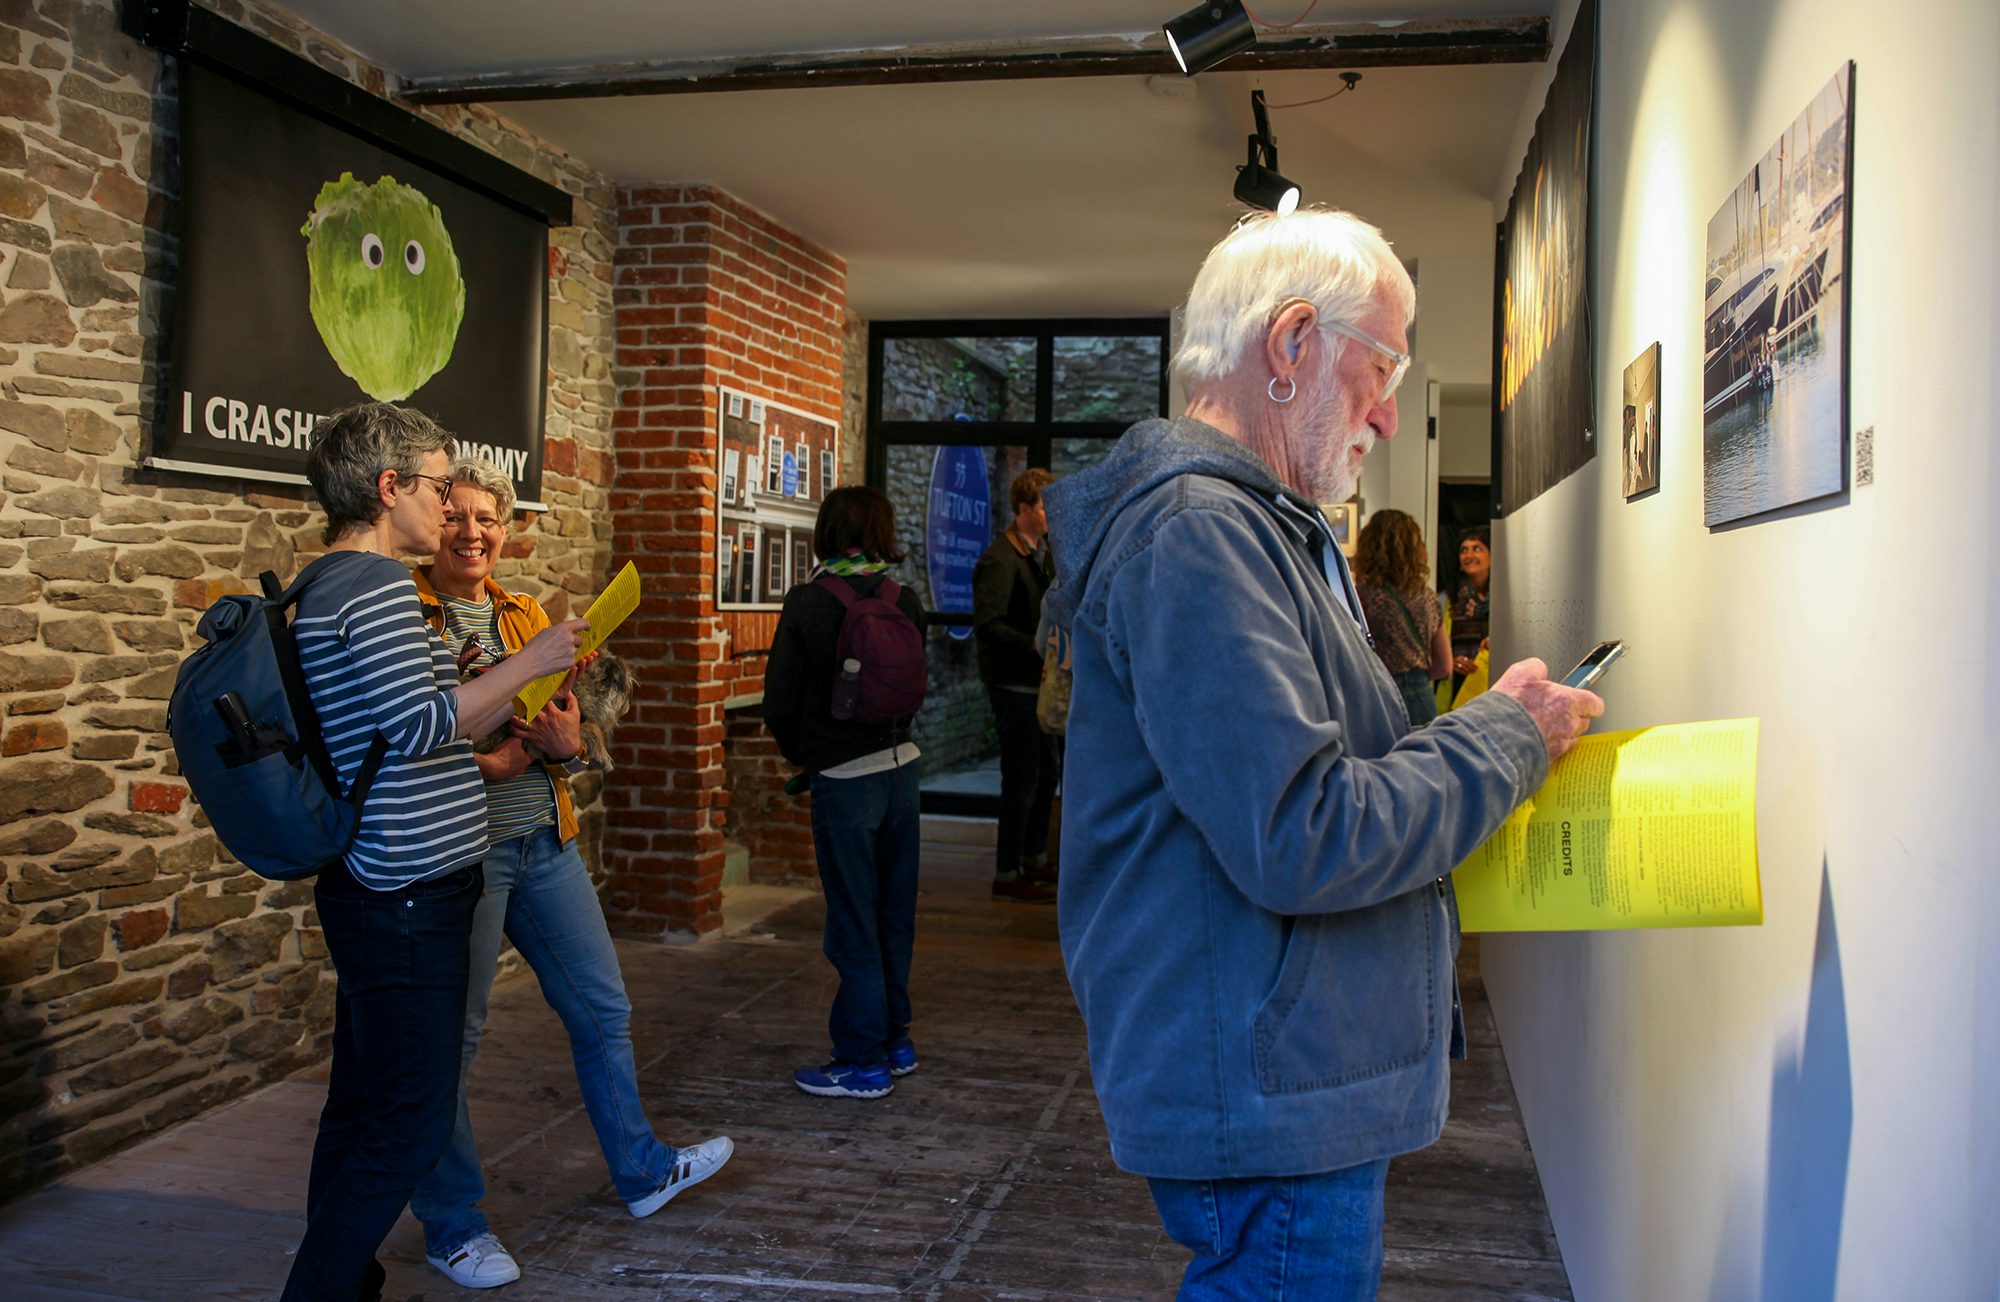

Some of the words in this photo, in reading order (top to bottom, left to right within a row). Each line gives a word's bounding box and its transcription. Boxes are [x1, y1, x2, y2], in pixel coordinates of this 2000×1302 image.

[182, 390, 192, 434] I
[204, 395, 331, 451] CRASH
[933, 488, 972, 522] TUFTON
[974, 500, 987, 527] ST
[1561, 821, 1573, 876] CREDITS
